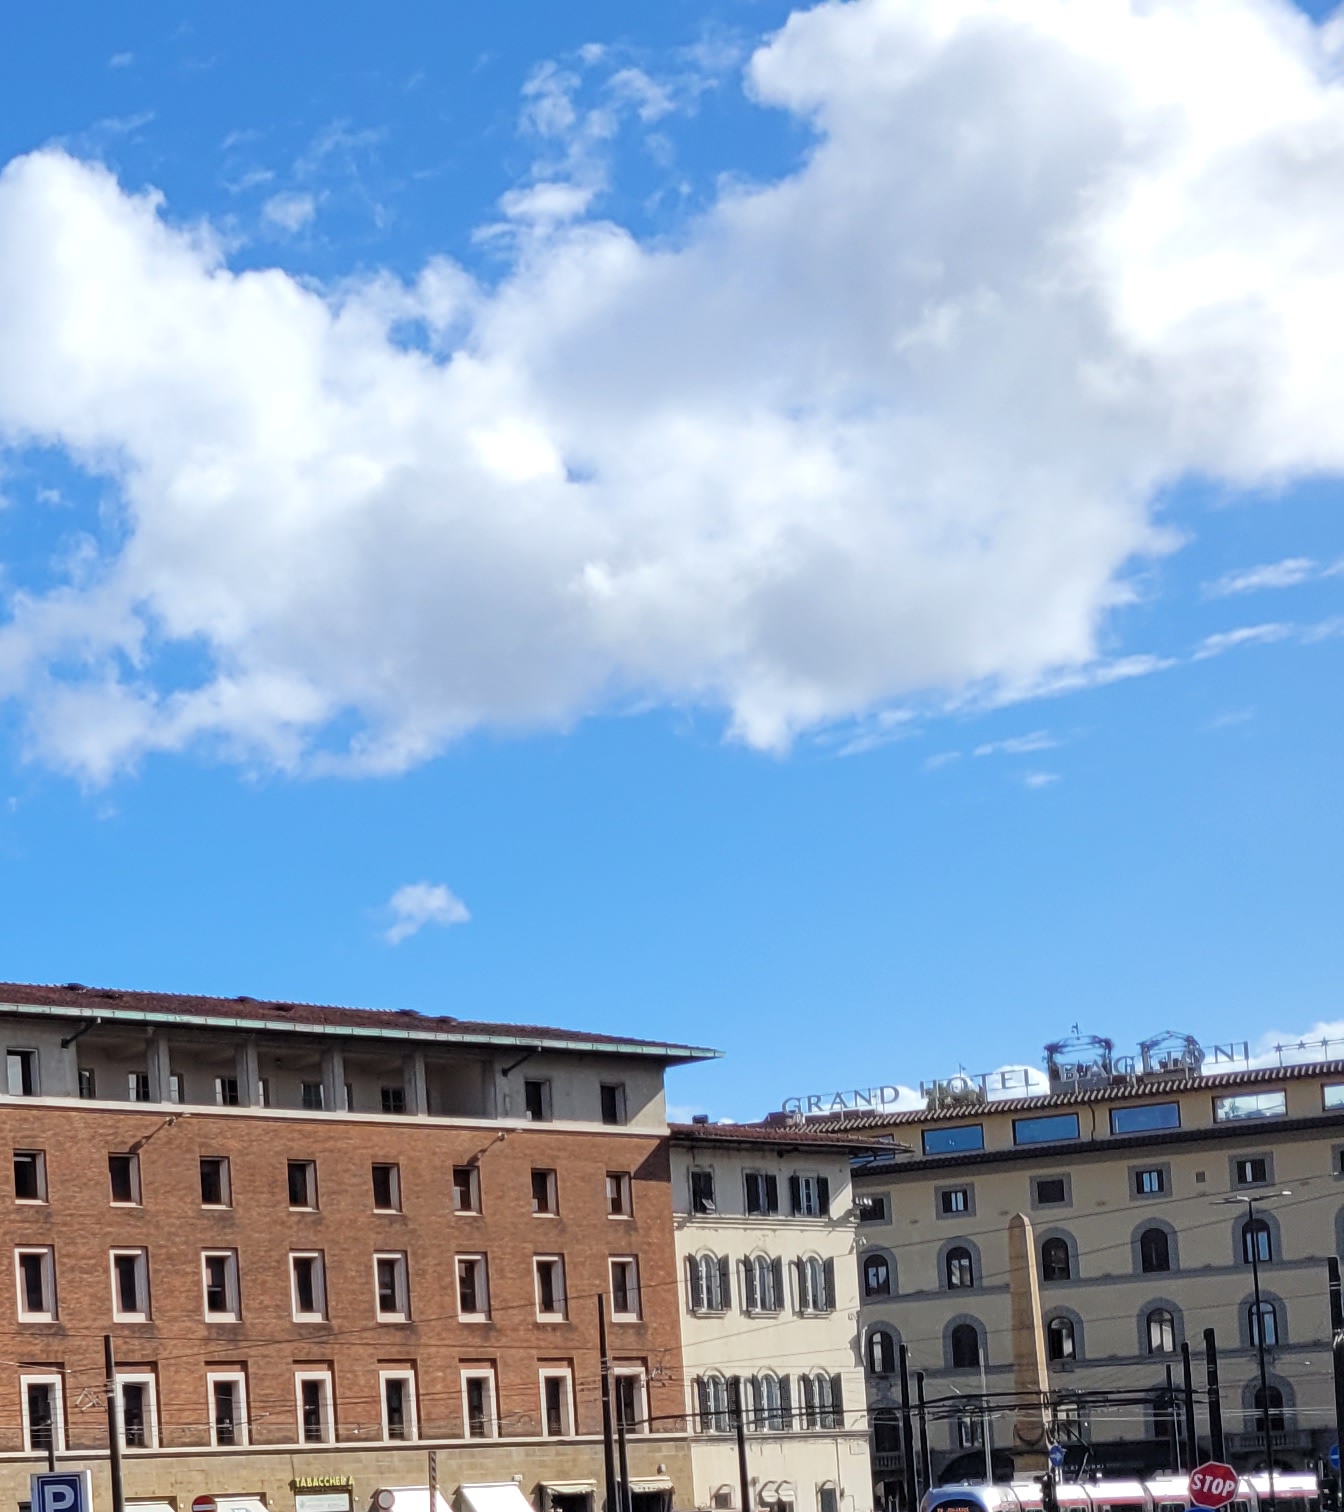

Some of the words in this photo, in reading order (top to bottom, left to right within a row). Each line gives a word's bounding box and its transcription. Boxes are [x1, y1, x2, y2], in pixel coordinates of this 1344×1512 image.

[782, 1085, 900, 1116] GRAND
[919, 1068, 1040, 1103] HOTEL
[1061, 1040, 1250, 1083] BAGLIONI
[296, 1475, 355, 1487] TABACCHERA
[1191, 1474, 1236, 1497] STOP
